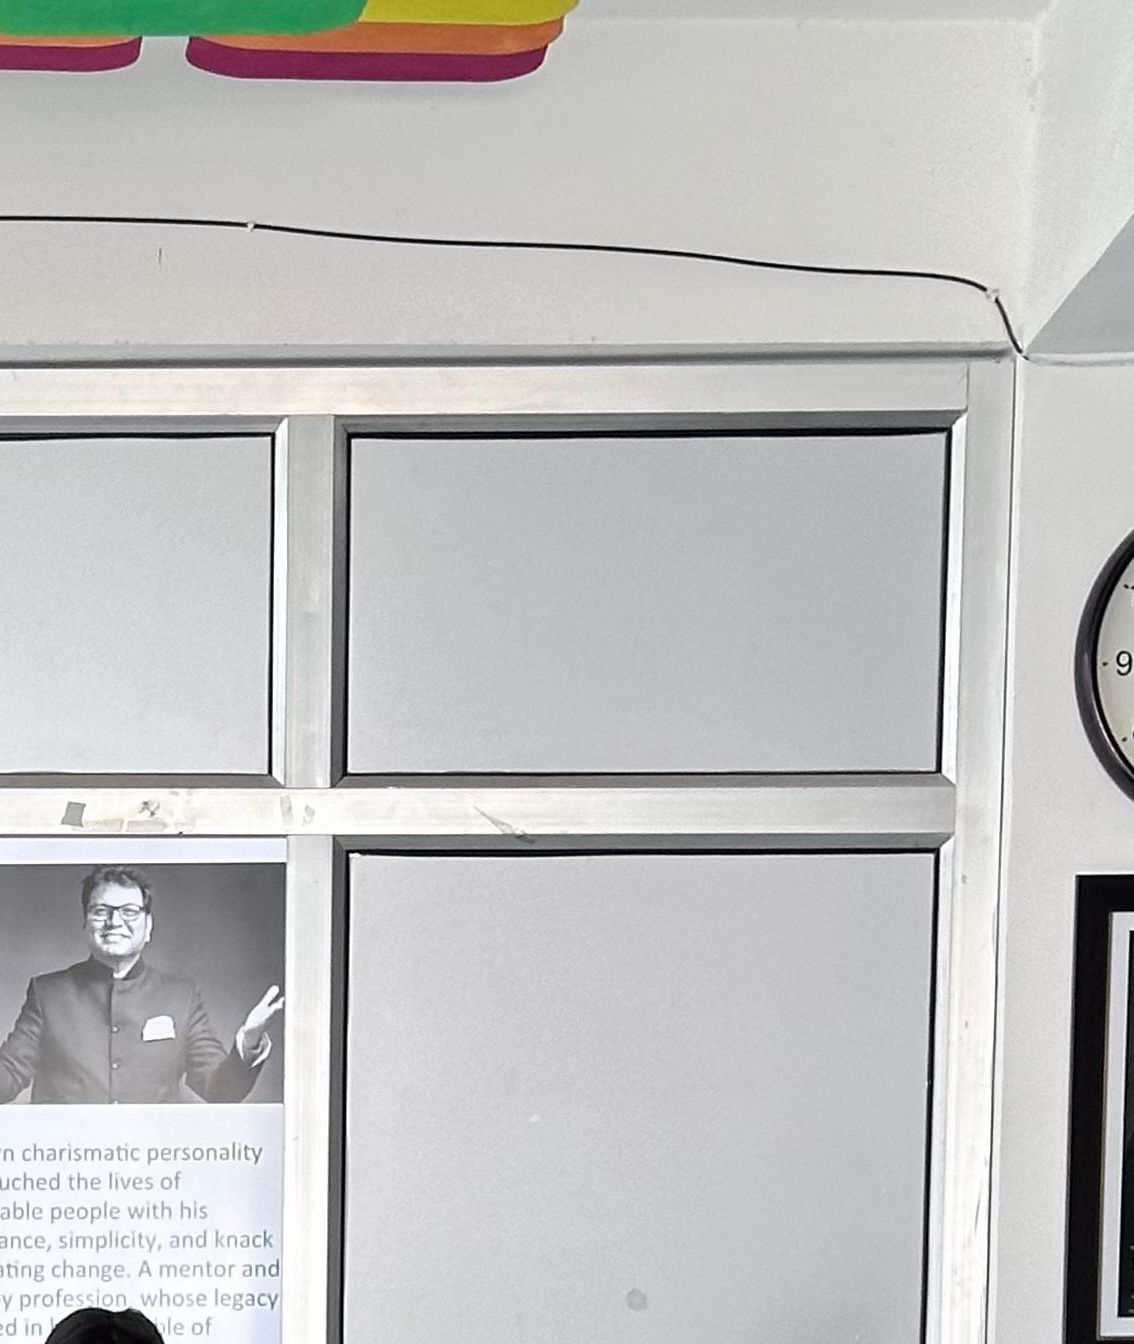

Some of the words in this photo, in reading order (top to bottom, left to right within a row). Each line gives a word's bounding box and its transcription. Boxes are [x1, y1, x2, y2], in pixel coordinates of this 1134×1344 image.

[1116, 650, 1133, 677] 9
[22, 1142, 140, 1162] charismatic
[147, 1142, 263, 1165] personality
[67, 1172, 101, 1191] the
[109, 1171, 154, 1191] lives
[160, 1171, 183, 1190] of
[51, 1201, 121, 1224] people
[127, 1200, 172, 1220] with
[180, 1200, 208, 1220] his
[59, 1230, 162, 1253] simplicity,
[169, 1229, 207, 1248] and
[215, 1229, 275, 1249] knack
[51, 1259, 131, 1282] change.
[138, 1260, 152, 1278] A
[159, 1261, 236, 1278] mentor
[242, 1259, 280, 1279] and
[140, 1288, 207, 1307] whose
[215, 1287, 278, 1311] legacy
[25, 1318, 42, 1336] in
[191, 1316, 213, 1336] of
